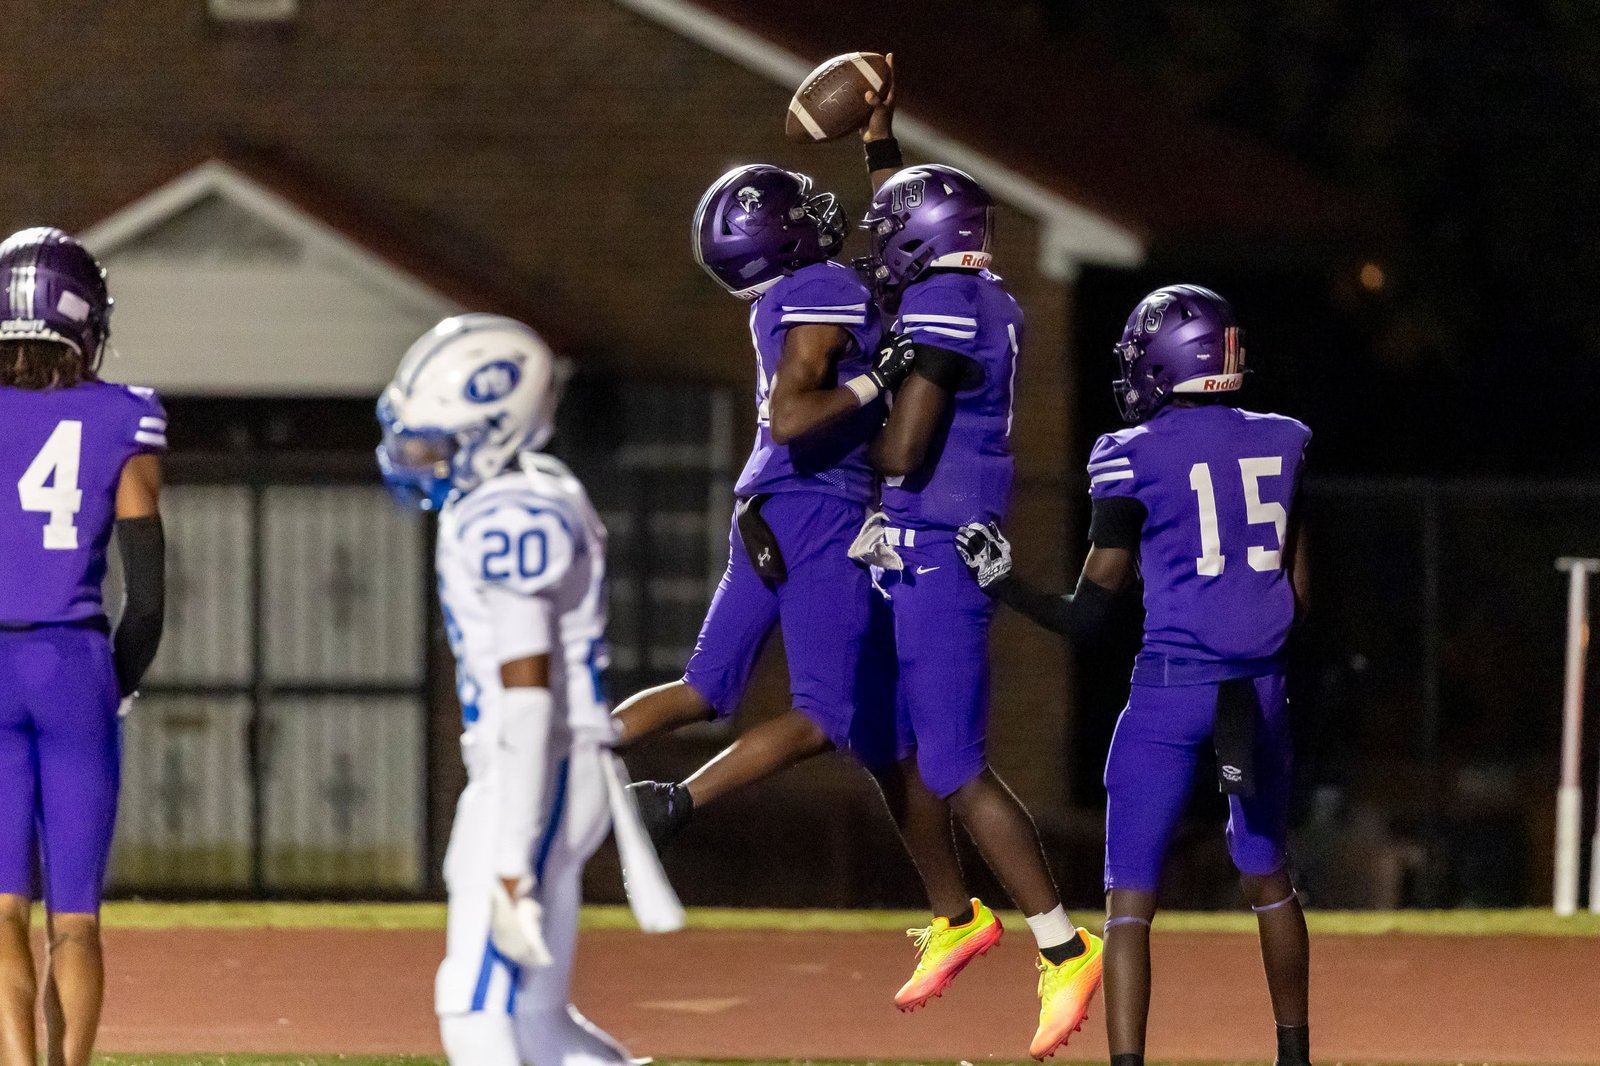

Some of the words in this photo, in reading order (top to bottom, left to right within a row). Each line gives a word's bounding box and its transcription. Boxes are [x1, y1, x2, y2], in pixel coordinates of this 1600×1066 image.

[892, 179, 926, 214] 13
[1133, 301, 1169, 335] 15
[17, 419, 83, 550] 4
[1189, 456, 1287, 577] 15
[480, 527, 548, 581] 20
